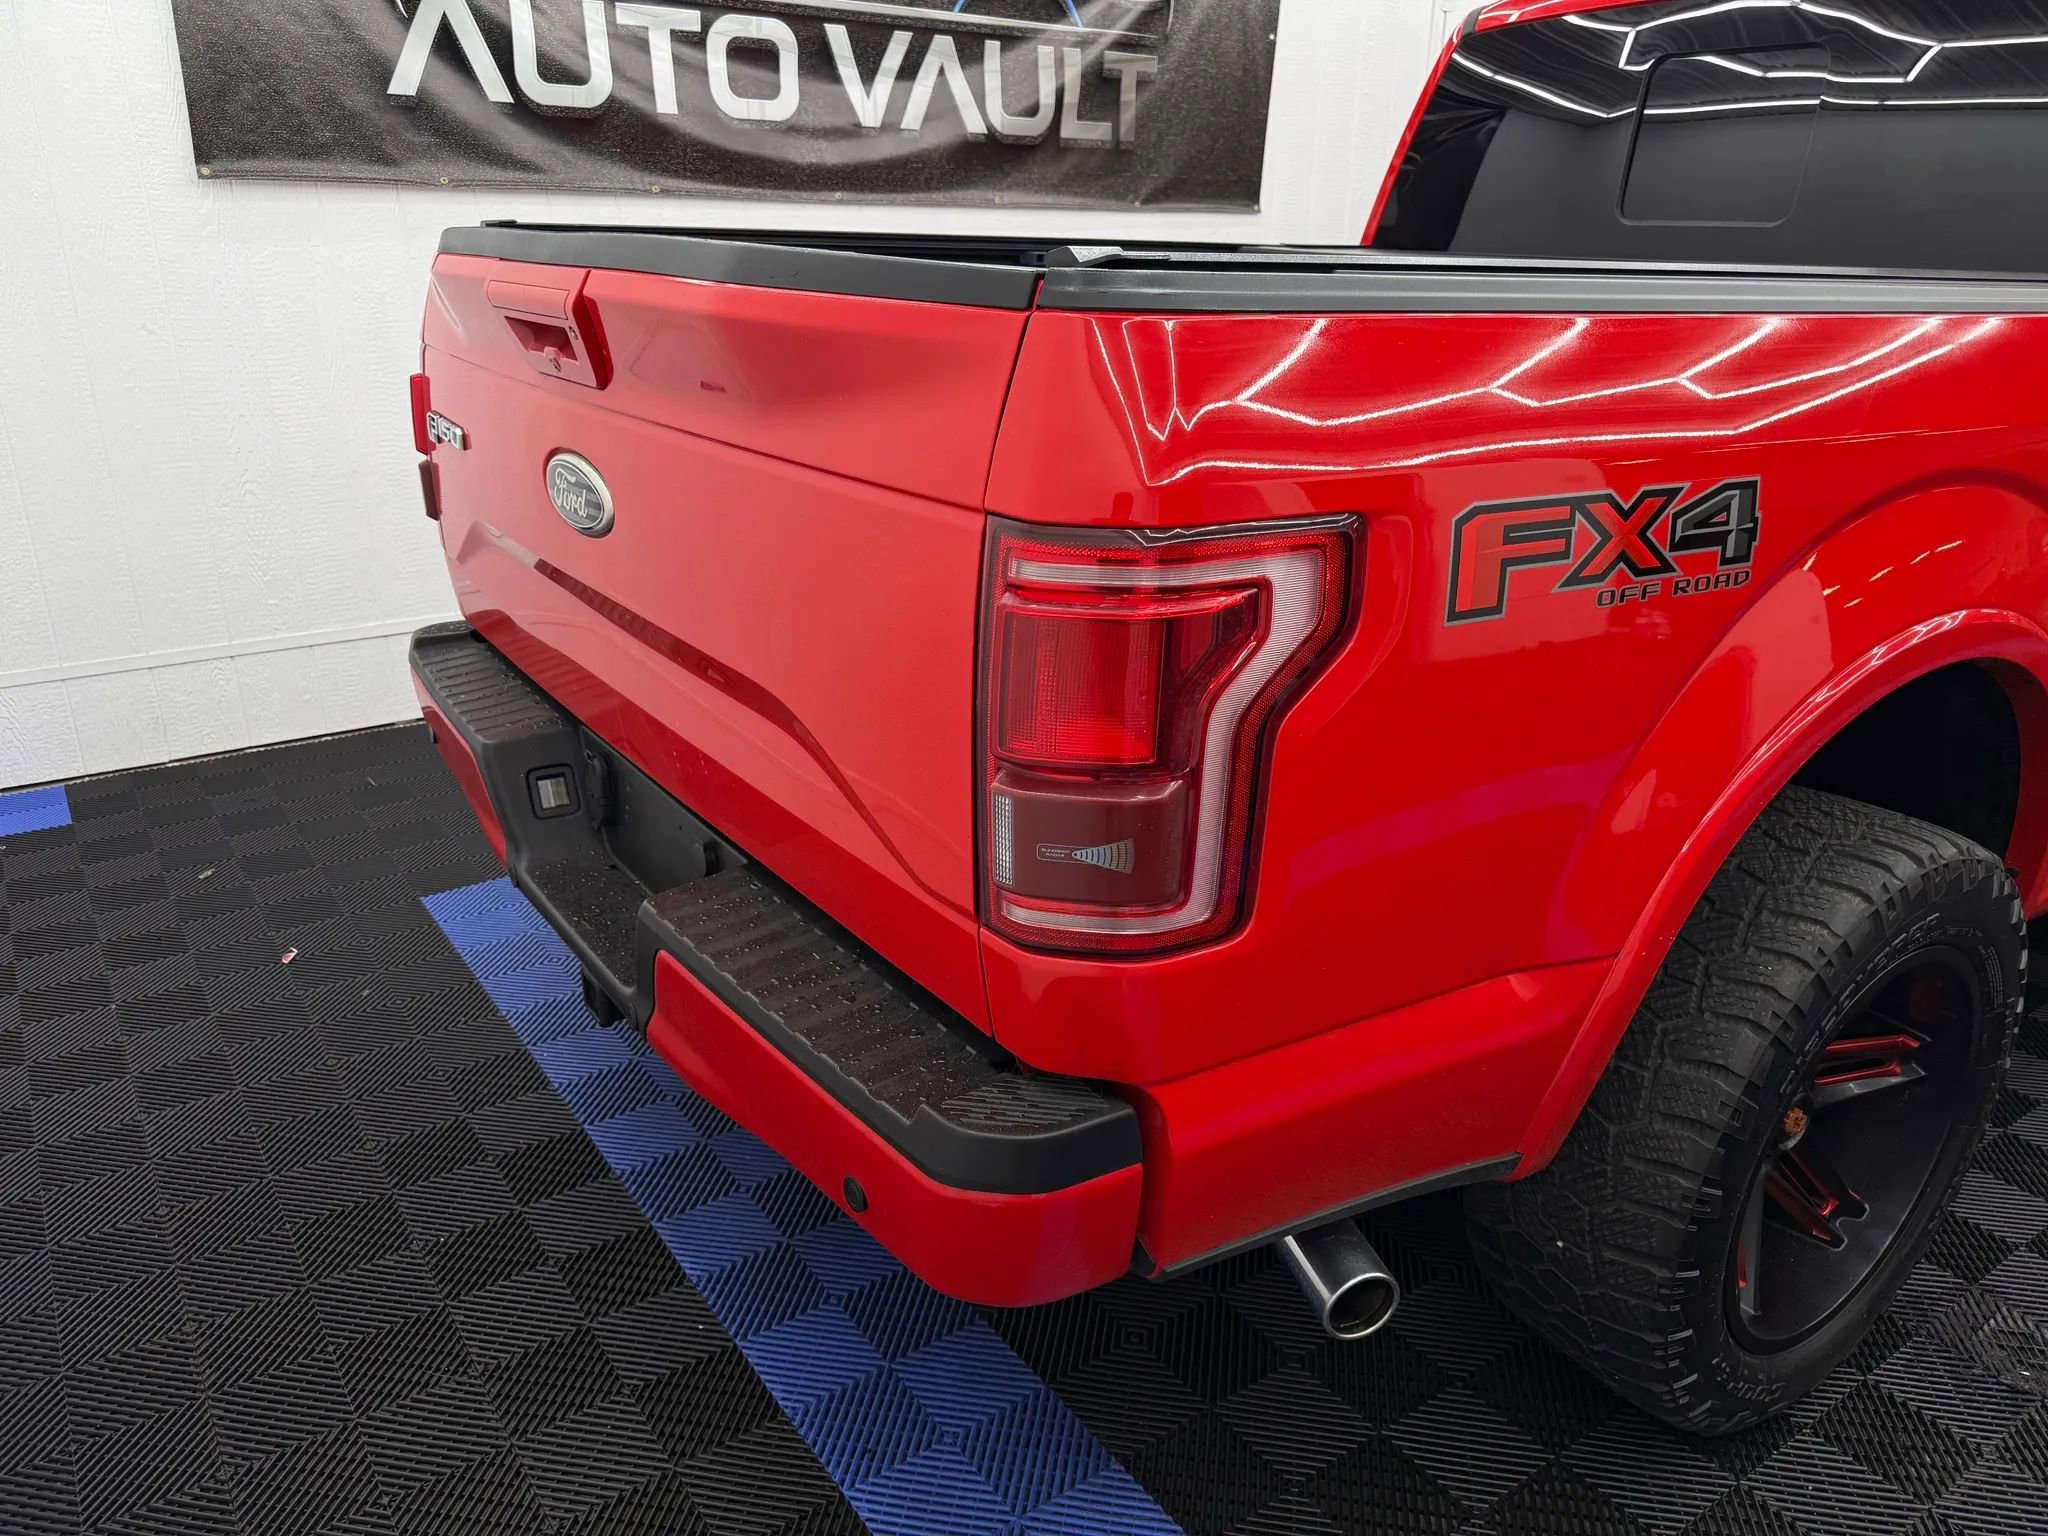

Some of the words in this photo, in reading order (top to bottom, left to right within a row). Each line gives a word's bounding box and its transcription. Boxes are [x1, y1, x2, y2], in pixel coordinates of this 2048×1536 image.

[386, 0, 799, 122] AUTO
[824, 23, 1158, 143] VAULT
[554, 467, 588, 518] Ford
[1443, 474, 1762, 628] FX4
[1595, 582, 1661, 609] OFF
[1672, 568, 1752, 597] ROAD
